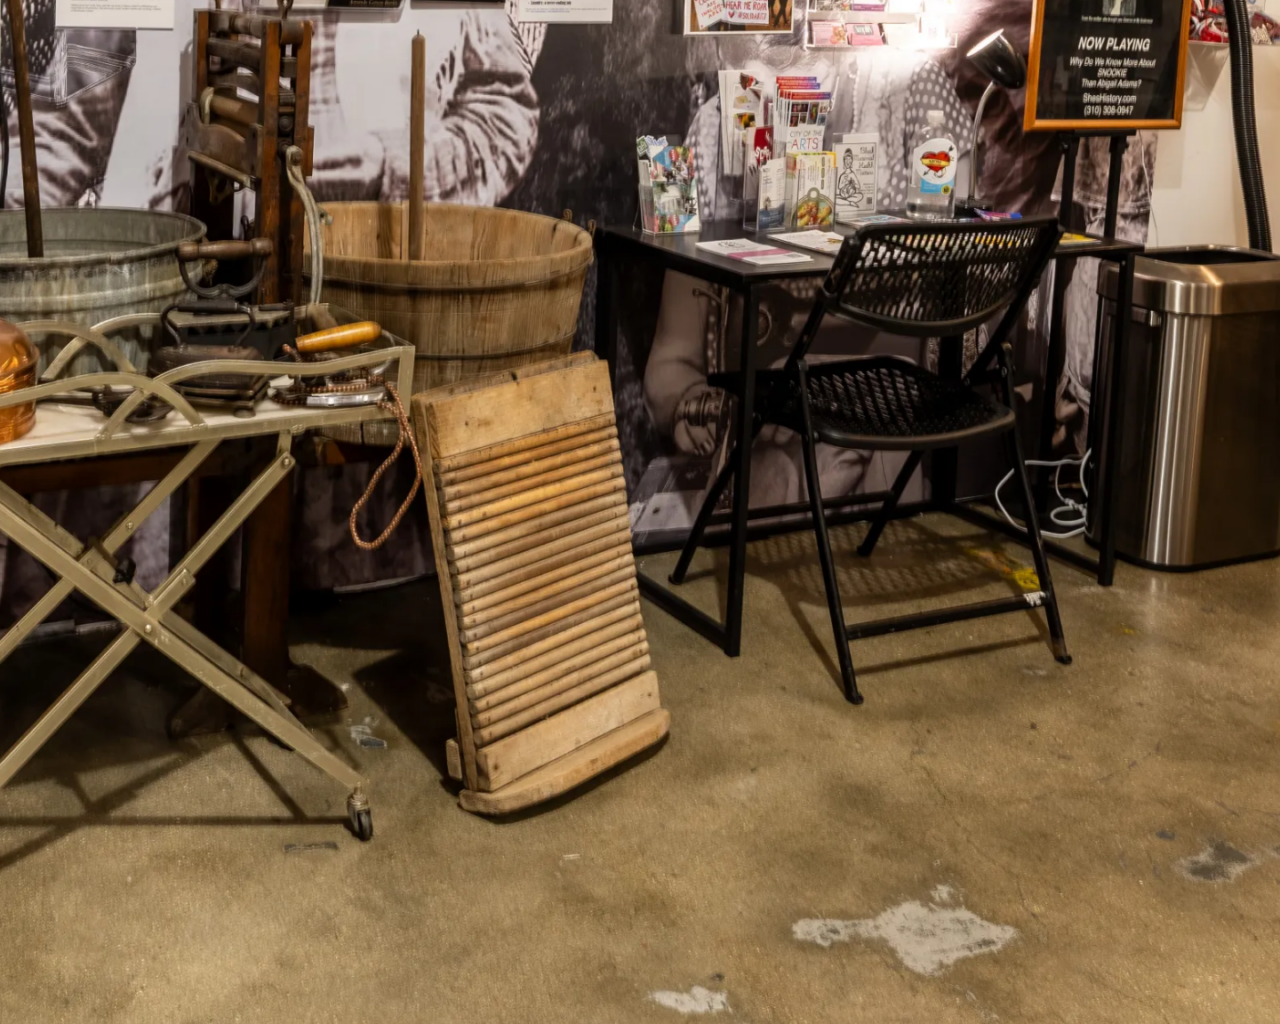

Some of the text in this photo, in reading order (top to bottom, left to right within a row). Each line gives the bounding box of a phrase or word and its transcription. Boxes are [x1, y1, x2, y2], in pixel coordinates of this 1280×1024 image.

[1078, 36, 1151, 52] NOW PLAYING
[1069, 56, 1157, 68] Why Do We Know More About
[1097, 68, 1128, 78] SNOOKIE
[1081, 78, 1142, 89] Than Abigail Adams?
[1082, 93, 1137, 105] ShesHistory.com
[1083, 104, 1101, 118] (310)
[789, 129, 822, 138] CITY OF THE
[791, 137, 819, 151] ARTS
